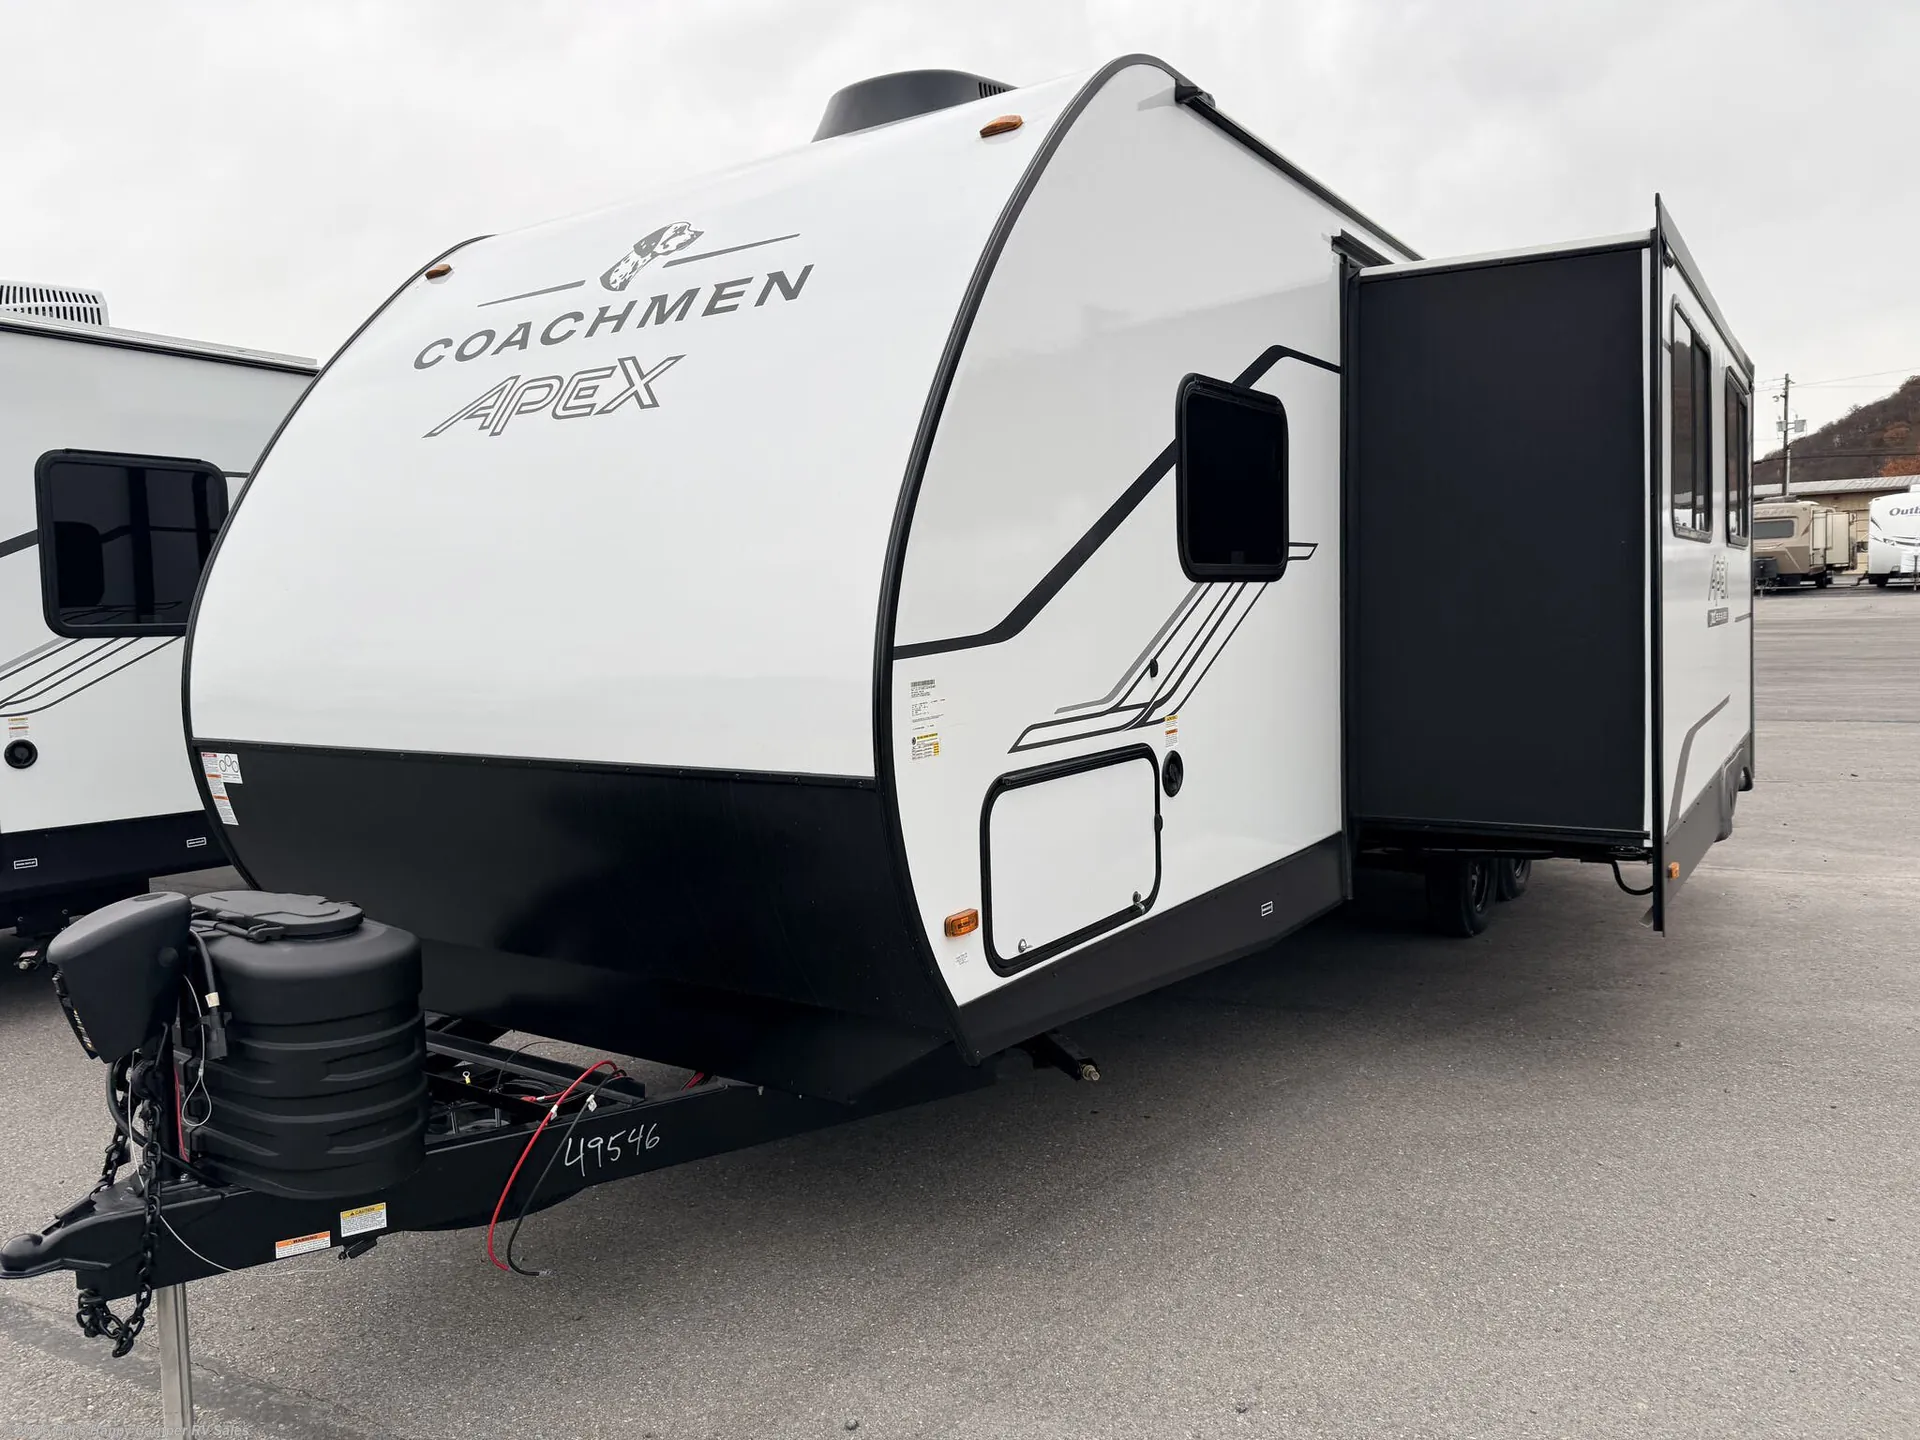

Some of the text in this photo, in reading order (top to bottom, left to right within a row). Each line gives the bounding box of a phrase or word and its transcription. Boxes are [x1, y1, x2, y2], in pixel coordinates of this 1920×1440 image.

[413, 264, 815, 371] COACHMEN
[421, 354, 686, 438] APEX
[564, 1123, 661, 1177] 49546
